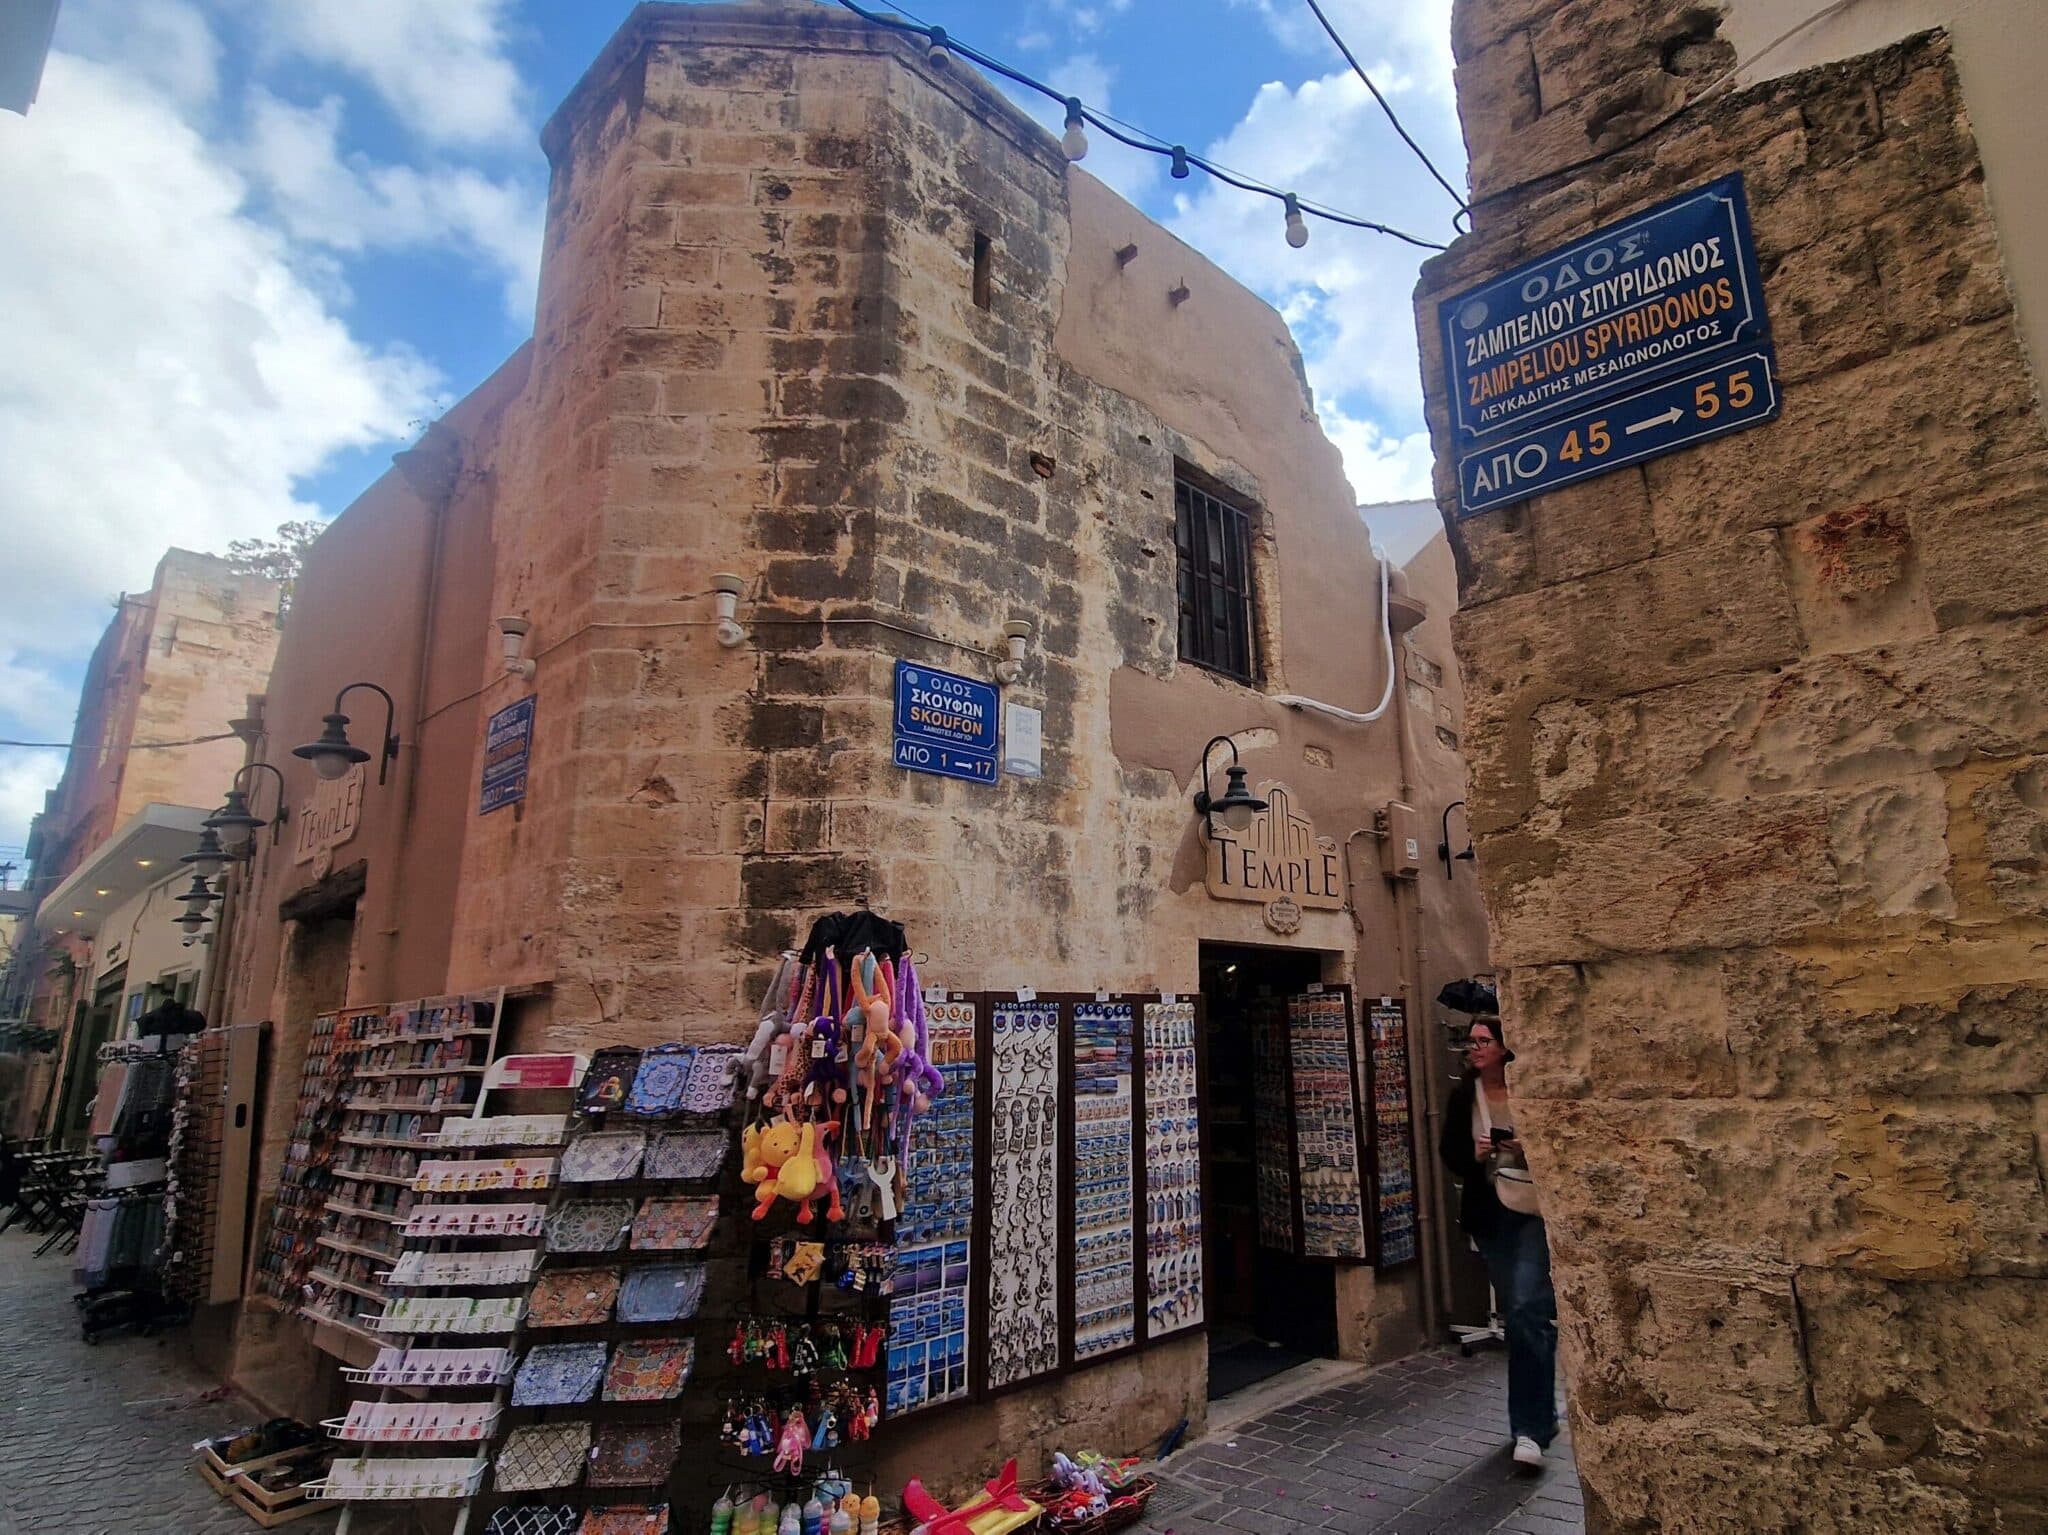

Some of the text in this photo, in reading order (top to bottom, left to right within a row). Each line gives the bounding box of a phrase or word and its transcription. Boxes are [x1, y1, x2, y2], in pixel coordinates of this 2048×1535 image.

[1521, 232, 1645, 303] ΟΔΟΣ
[1465, 236, 1725, 367] ΖΑΜΠΕΛΙΟΥ ΣΠΥΡΙΔΩΝΟΣ
[1467, 277, 1734, 406] ZAMPELIOU SPYRIDONOS
[1480, 320, 1722, 423] ΛΕΥΚΑΔΙΤΗΣ ΜΕΣΑΙΩΝΟΛΟΓΟΣ
[1472, 370, 1754, 497] ΑΠΟ 45 55
[910, 706, 982, 735] SKOUFON
[911, 688, 983, 718] ΣΚΟΥΦΩΝ
[930, 677, 972, 698] ΟΔΟΣ
[899, 744, 992, 776] ΑΠΟ 1 17
[1208, 836, 1339, 898] TEMPLE
